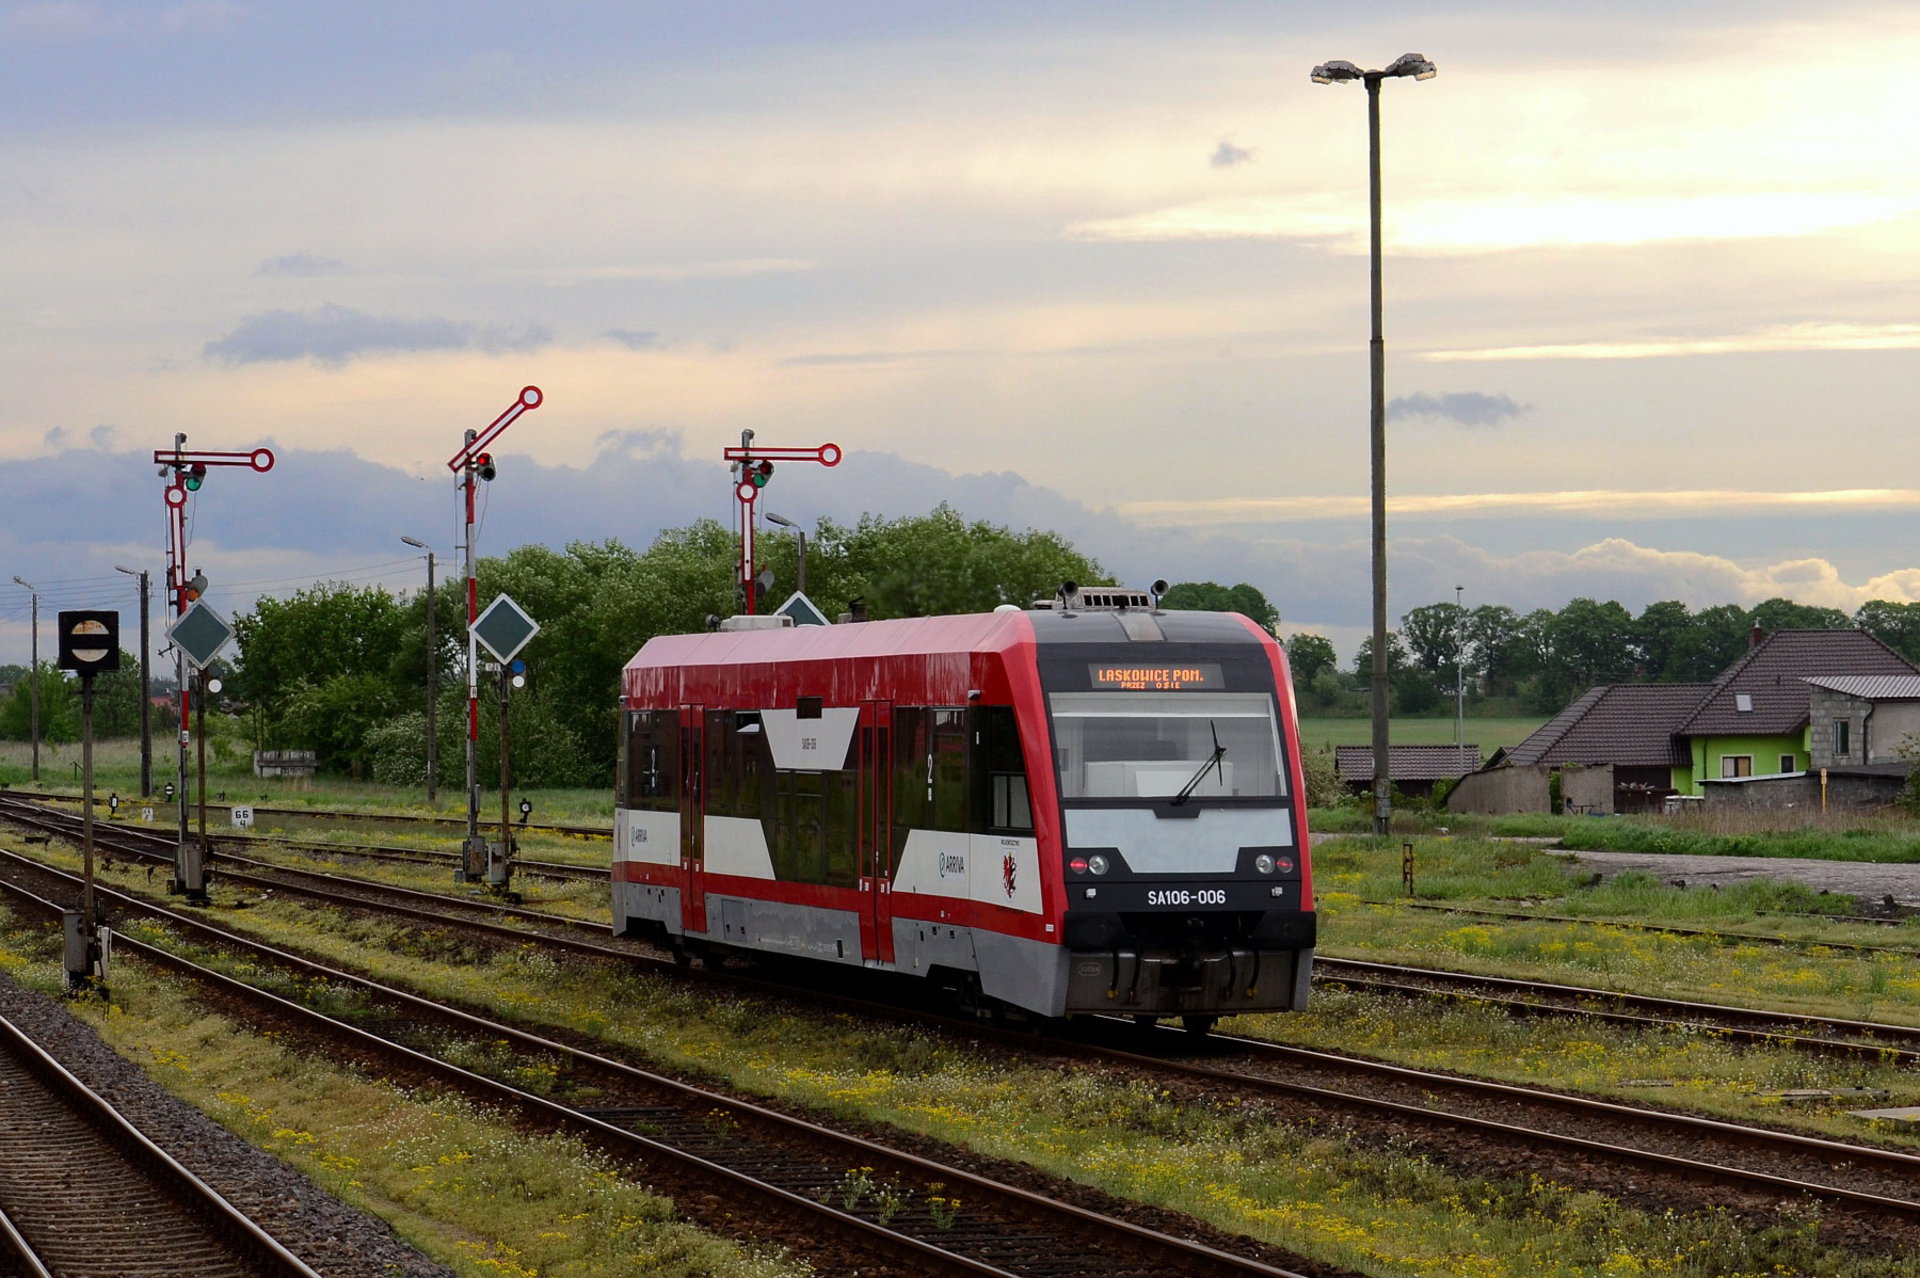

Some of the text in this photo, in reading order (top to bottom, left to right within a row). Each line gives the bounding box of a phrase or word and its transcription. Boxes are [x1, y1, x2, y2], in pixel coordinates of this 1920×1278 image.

[1098, 669, 1204, 682] LASKOWICE POM.
[927, 753, 933, 783] 2
[235, 810, 249, 819] 66
[239, 819, 246, 828] 4
[945, 855, 965, 874] ARRIVA
[1147, 889, 1227, 905] SA106-006
